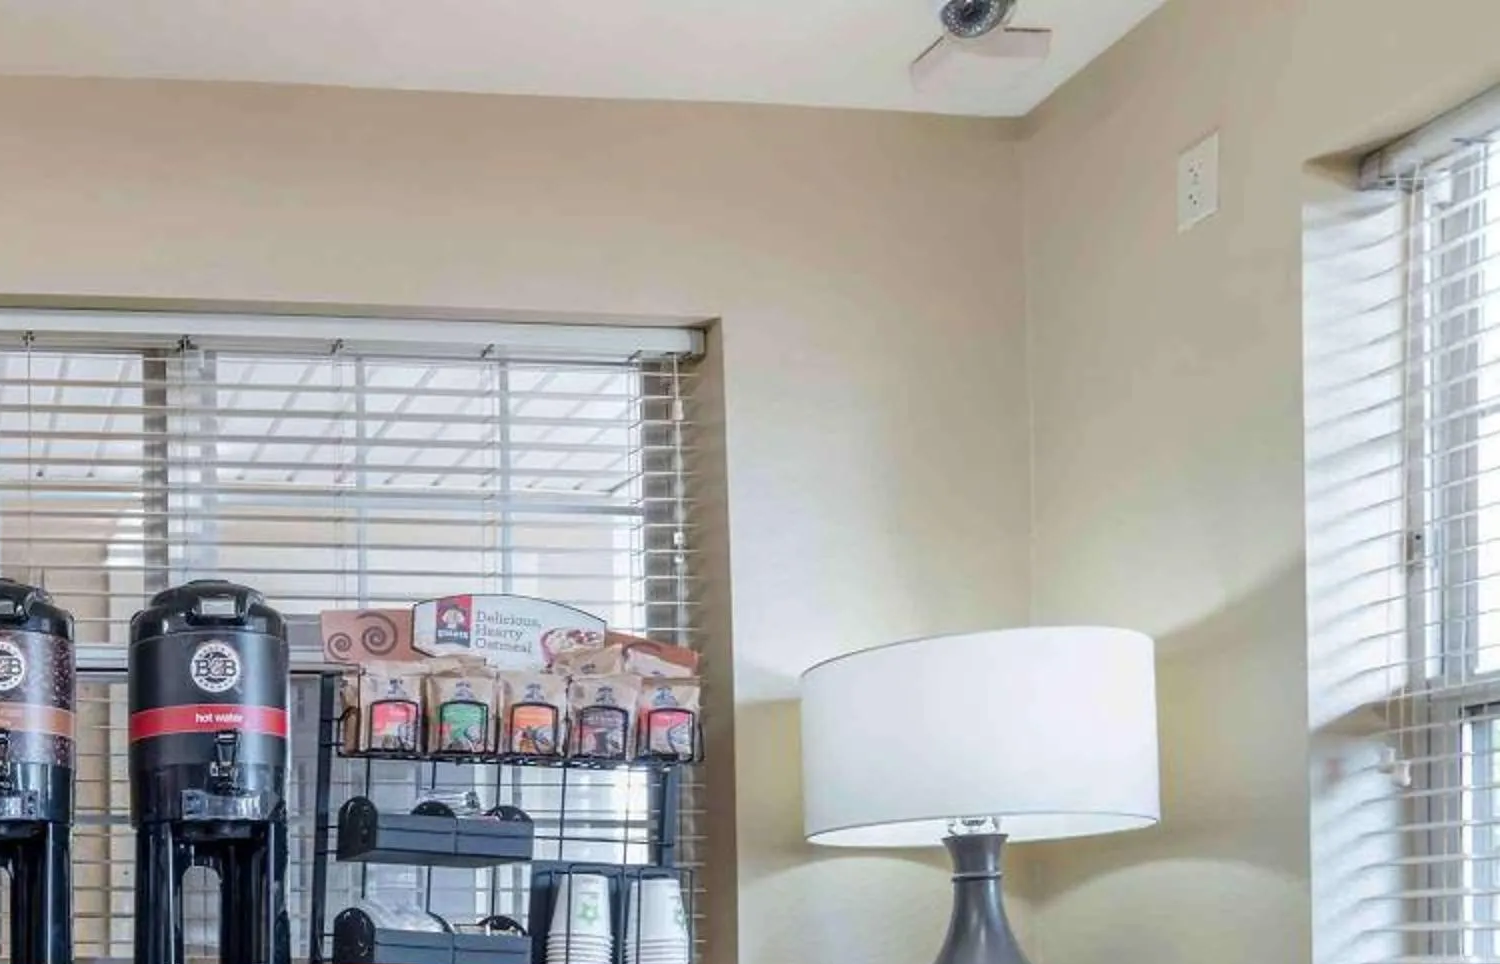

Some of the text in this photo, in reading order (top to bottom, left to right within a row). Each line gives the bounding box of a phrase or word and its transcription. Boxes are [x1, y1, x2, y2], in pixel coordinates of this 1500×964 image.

[476, 623, 524, 641] Hearty
[476, 638, 532, 654] Oatmeal
[195, 713, 243, 723] hot water
